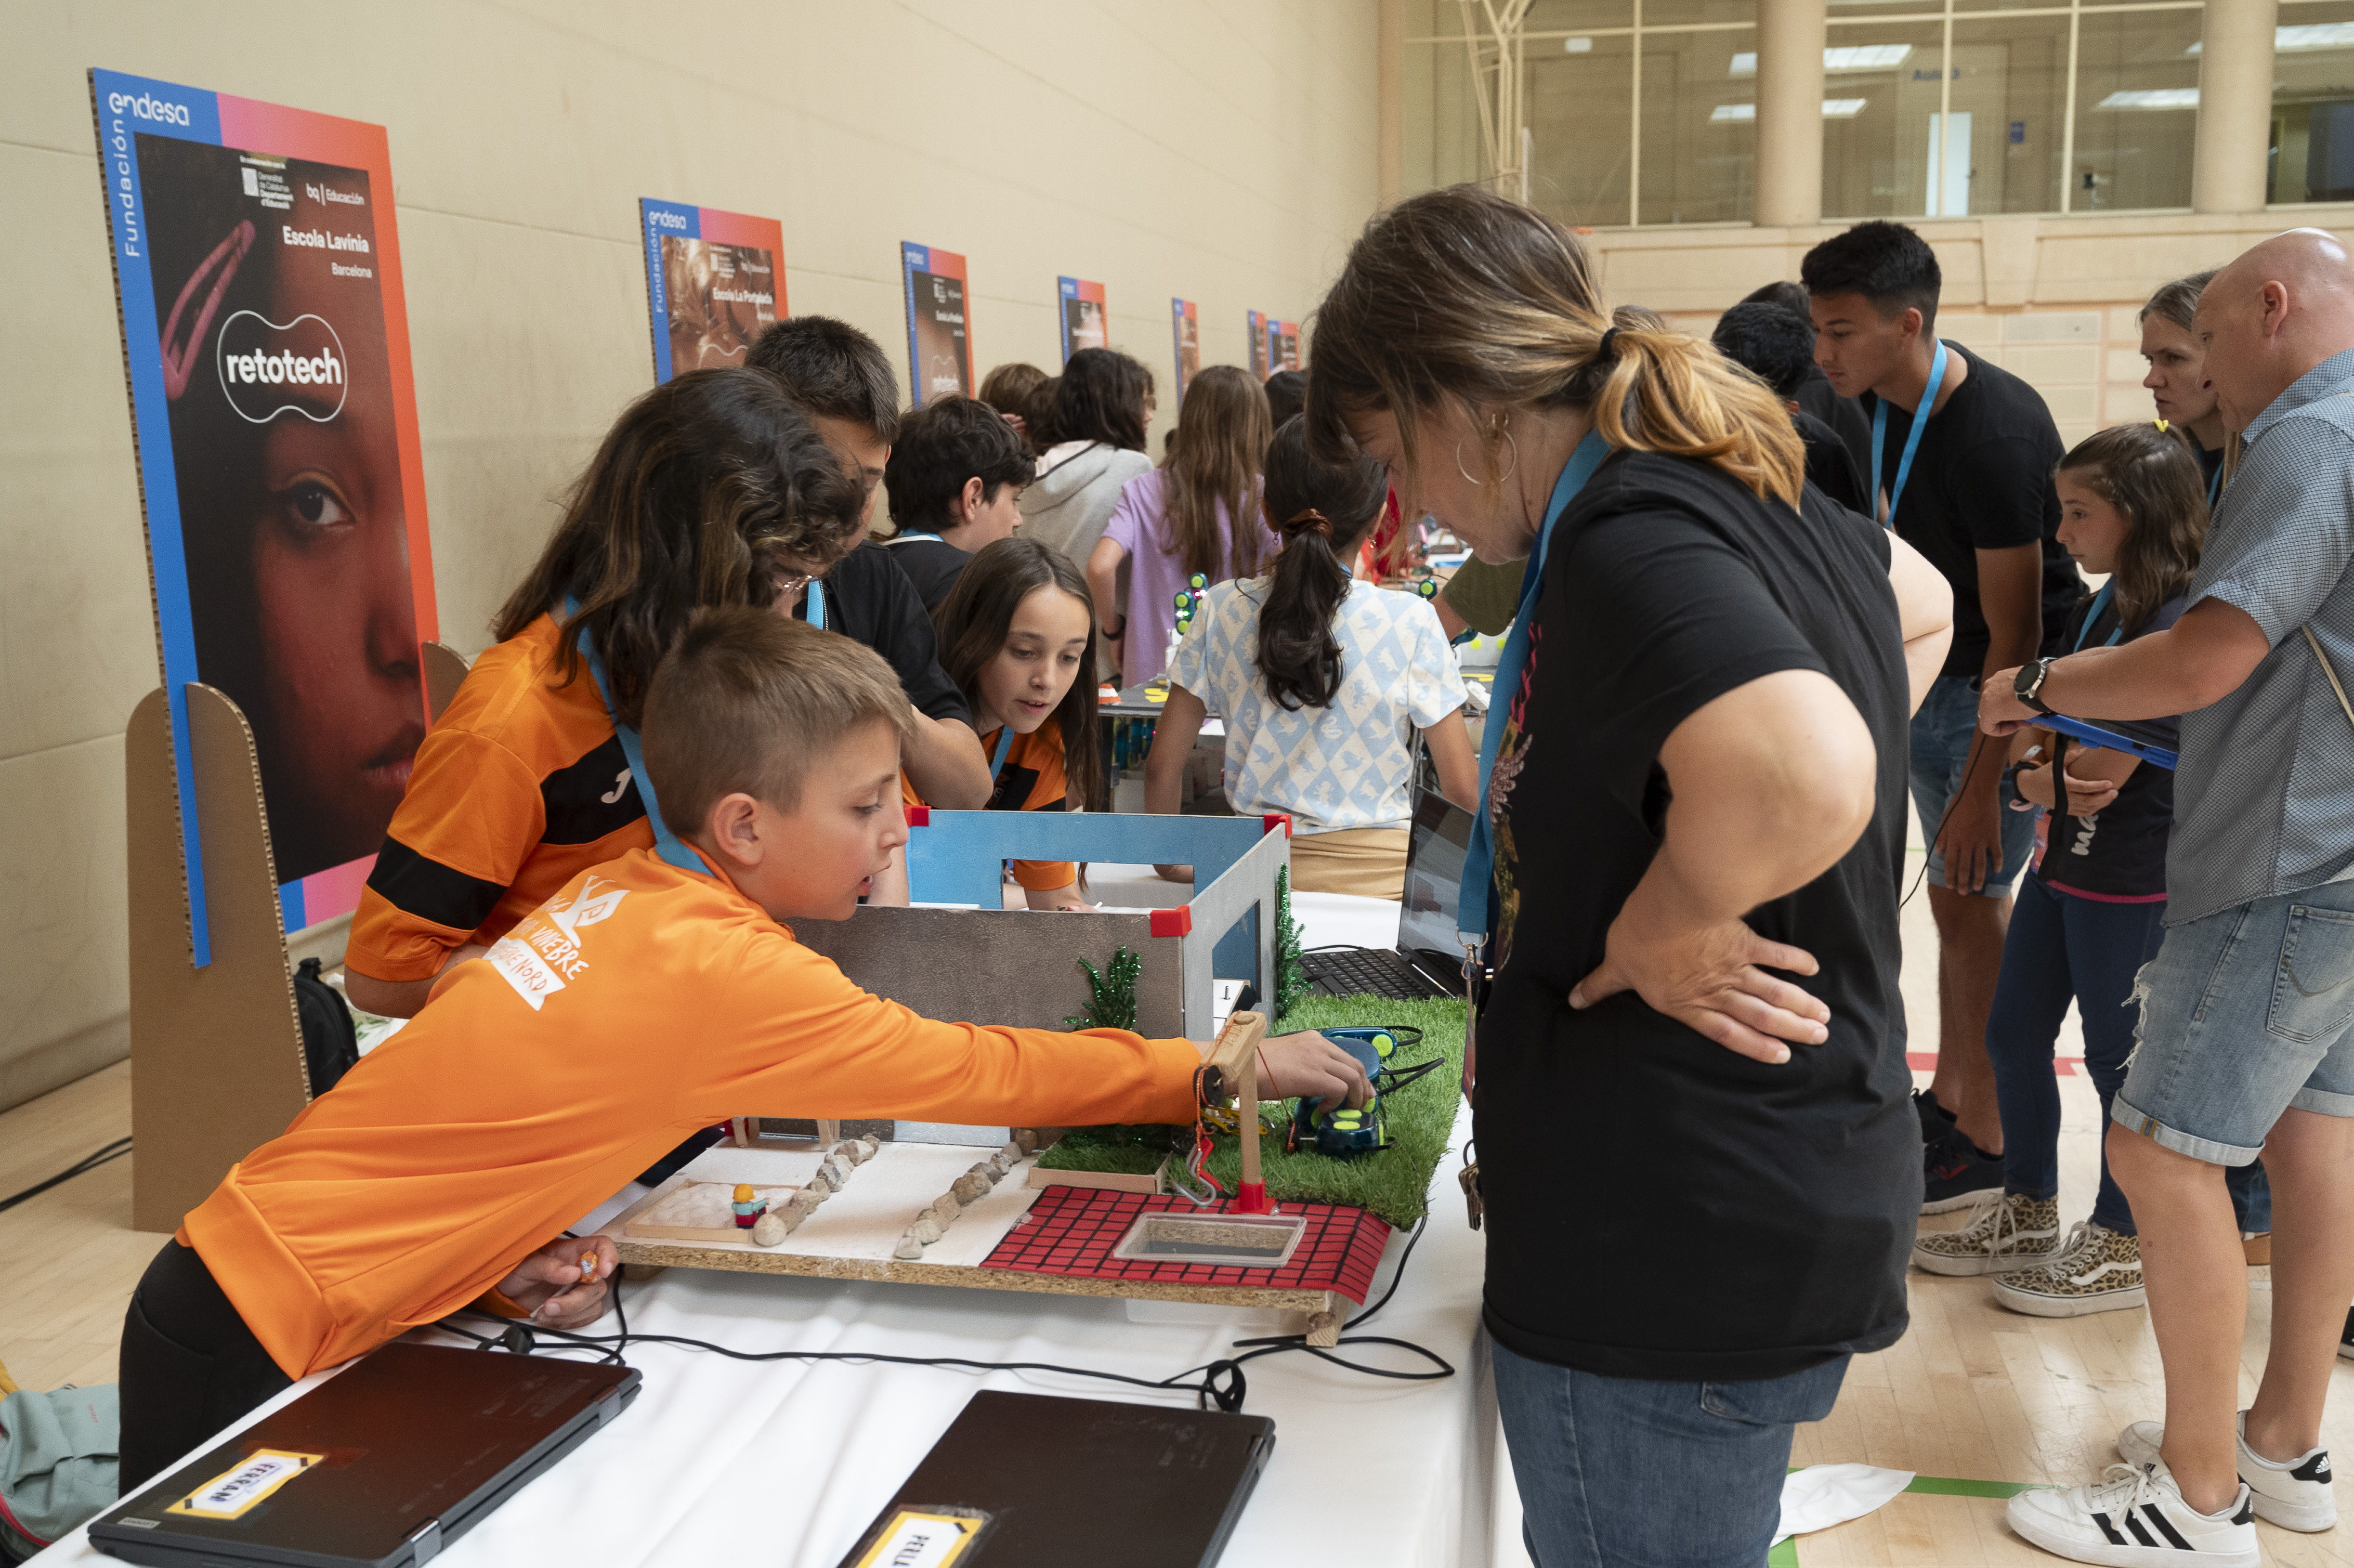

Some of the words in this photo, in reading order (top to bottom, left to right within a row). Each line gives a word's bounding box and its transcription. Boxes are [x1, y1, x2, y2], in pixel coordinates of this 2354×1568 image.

[109, 92, 190, 126] endesa
[112, 119, 141, 257] Fundación
[648, 211, 687, 230] endesa
[282, 226, 326, 249] Escola
[331, 262, 373, 279] Barcelona
[226, 347, 342, 385] retotech
